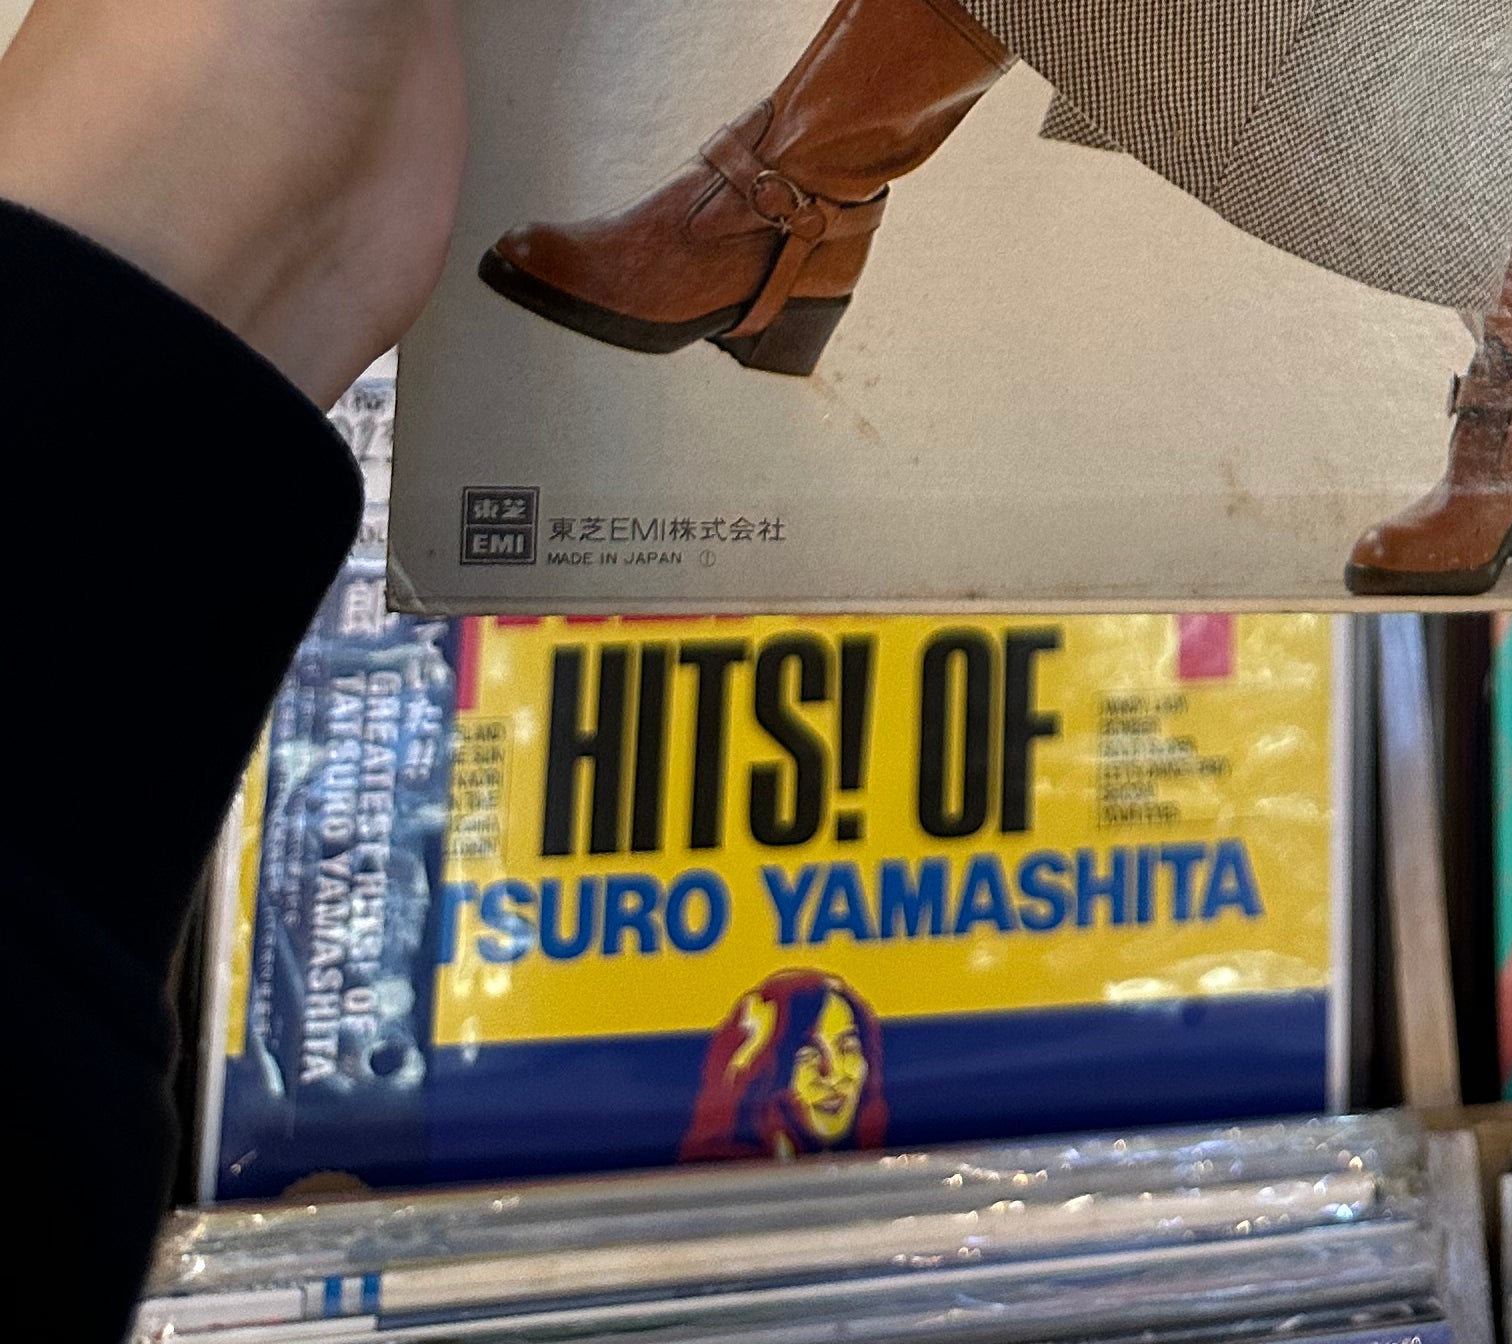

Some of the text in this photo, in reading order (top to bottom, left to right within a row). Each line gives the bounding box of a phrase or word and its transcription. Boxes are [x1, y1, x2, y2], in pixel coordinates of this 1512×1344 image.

[473, 498, 527, 520] 東芝
[548, 516, 788, 543] 東芝EMI株式会社
[472, 533, 526, 554] EMI
[548, 551, 593, 565] MADE
[600, 551, 618, 565] IN
[622, 551, 683, 566] JAPAN
[542, 630, 878, 858] HITS!
[916, 624, 1064, 839] OF
[302, 671, 366, 1084] TATSURO YAMASHITA
[759, 836, 1265, 949] YAMASHITA
[341, 985, 377, 1040] OF
